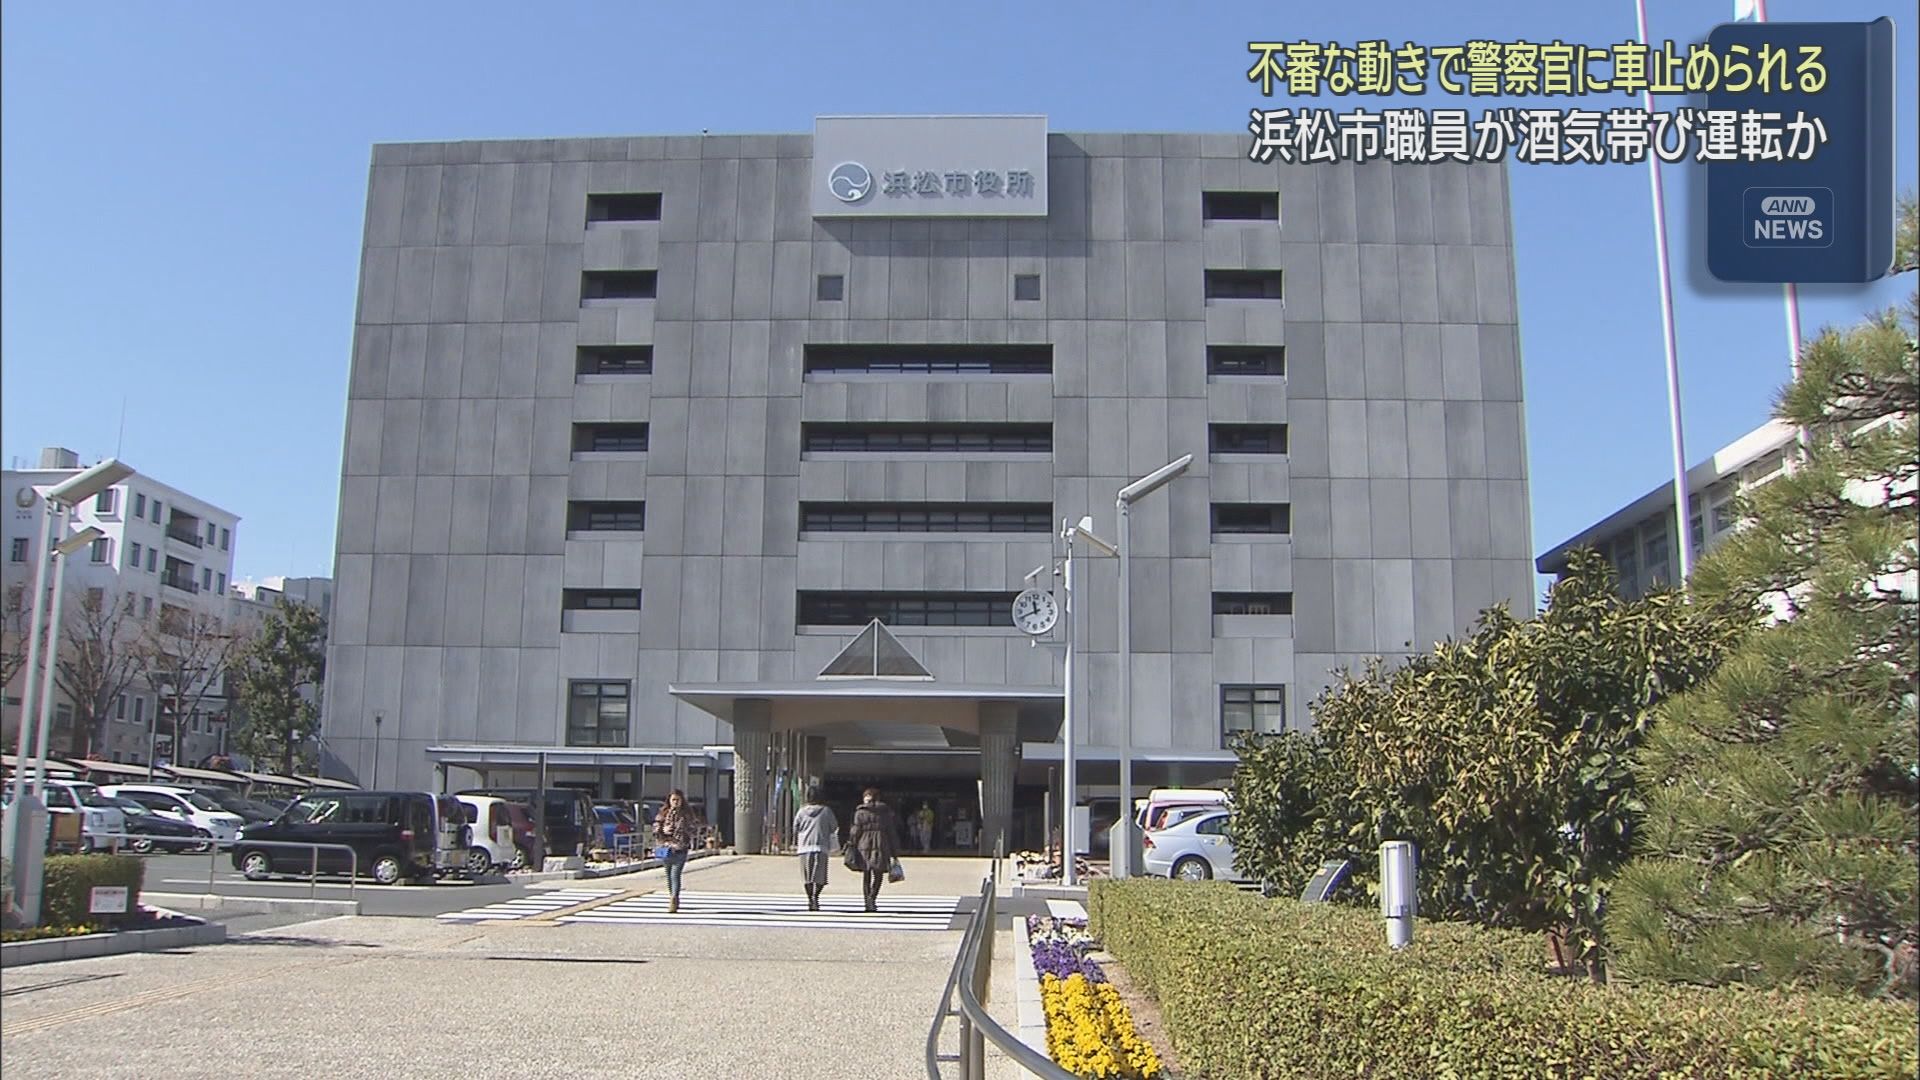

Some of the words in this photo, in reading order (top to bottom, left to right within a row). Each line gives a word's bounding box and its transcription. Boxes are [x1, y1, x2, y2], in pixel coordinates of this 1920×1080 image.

[882, 169, 1035, 197] 浜松市役所
